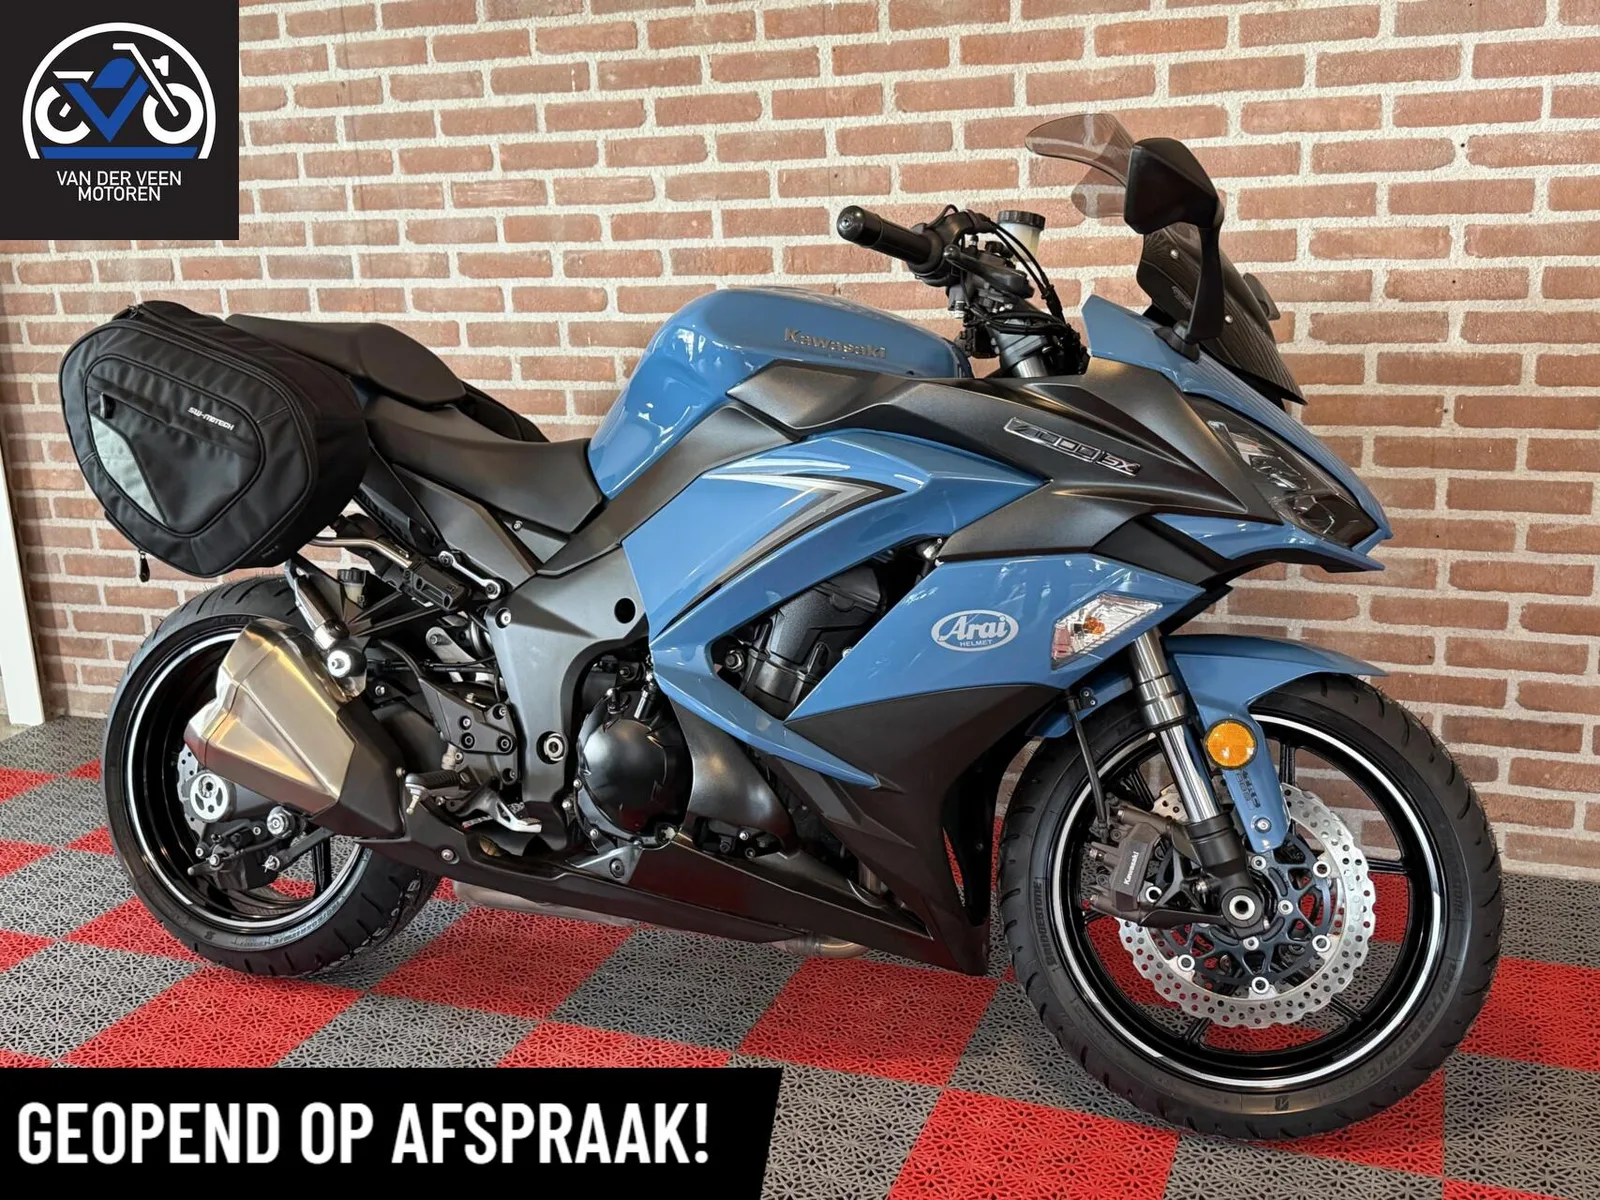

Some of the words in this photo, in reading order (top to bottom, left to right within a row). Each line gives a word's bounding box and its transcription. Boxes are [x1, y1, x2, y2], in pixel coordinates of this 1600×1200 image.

[784, 327, 886, 358] Kawasaki
[938, 615, 1008, 640] Arai
[960, 640, 993, 648] HELMET
[1123, 850, 1139, 886] Kawasaki
